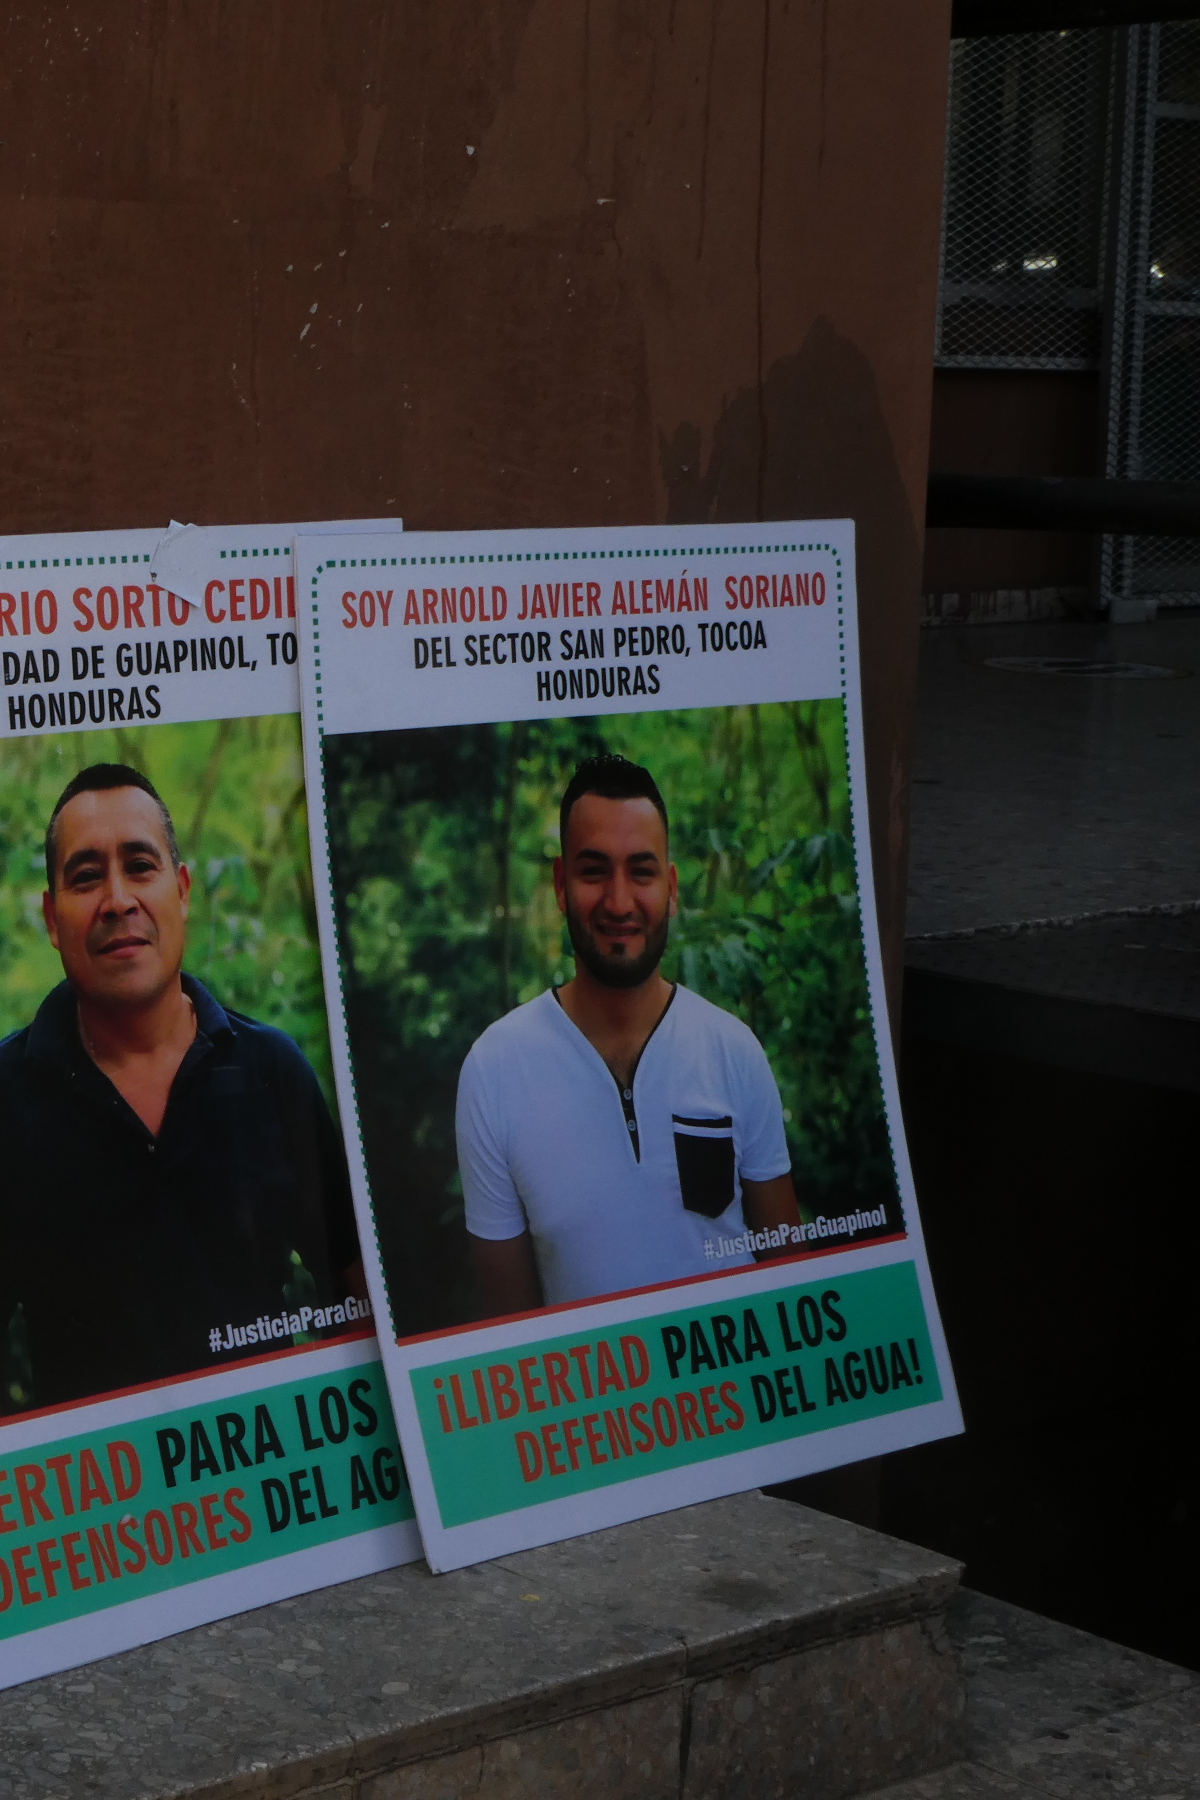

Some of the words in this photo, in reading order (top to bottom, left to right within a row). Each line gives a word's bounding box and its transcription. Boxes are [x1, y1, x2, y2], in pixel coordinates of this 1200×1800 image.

[341, 590, 394, 629] SOY
[403, 585, 508, 626] ARNOLD
[517, 582, 601, 620] JAVIER
[612, 570, 709, 616] ALEMÁN
[724, 571, 826, 610] SORIANO
[71, 645, 105, 680] DE
[116, 635, 257, 677] GUAPINOL,
[413, 637, 457, 669] DEL
[464, 631, 552, 665] SECTOR
[560, 628, 604, 662] SAN
[614, 625, 691, 657] PEDRO,
[698, 620, 767, 652] TOCOA
[8, 685, 161, 730] HONDURAS
[536, 664, 661, 702] HONDURAS
[703, 1204, 887, 1260] #JusticiaParaGuapinol
[208, 1296, 373, 1353] #JusticiaParaGu
[433, 1334, 650, 1433] ¡LIBERTAD
[661, 1308, 769, 1379] PARA
[776, 1289, 847, 1352] LOS
[156, 1404, 286, 1488] PARA
[295, 1378, 378, 1452] LOS
[514, 1380, 746, 1483] DEFENSORES
[751, 1367, 816, 1423] DEL
[825, 1338, 924, 1406] AGUA!
[261, 1463, 338, 1533] DEL
[350, 1446, 408, 1510] AG
